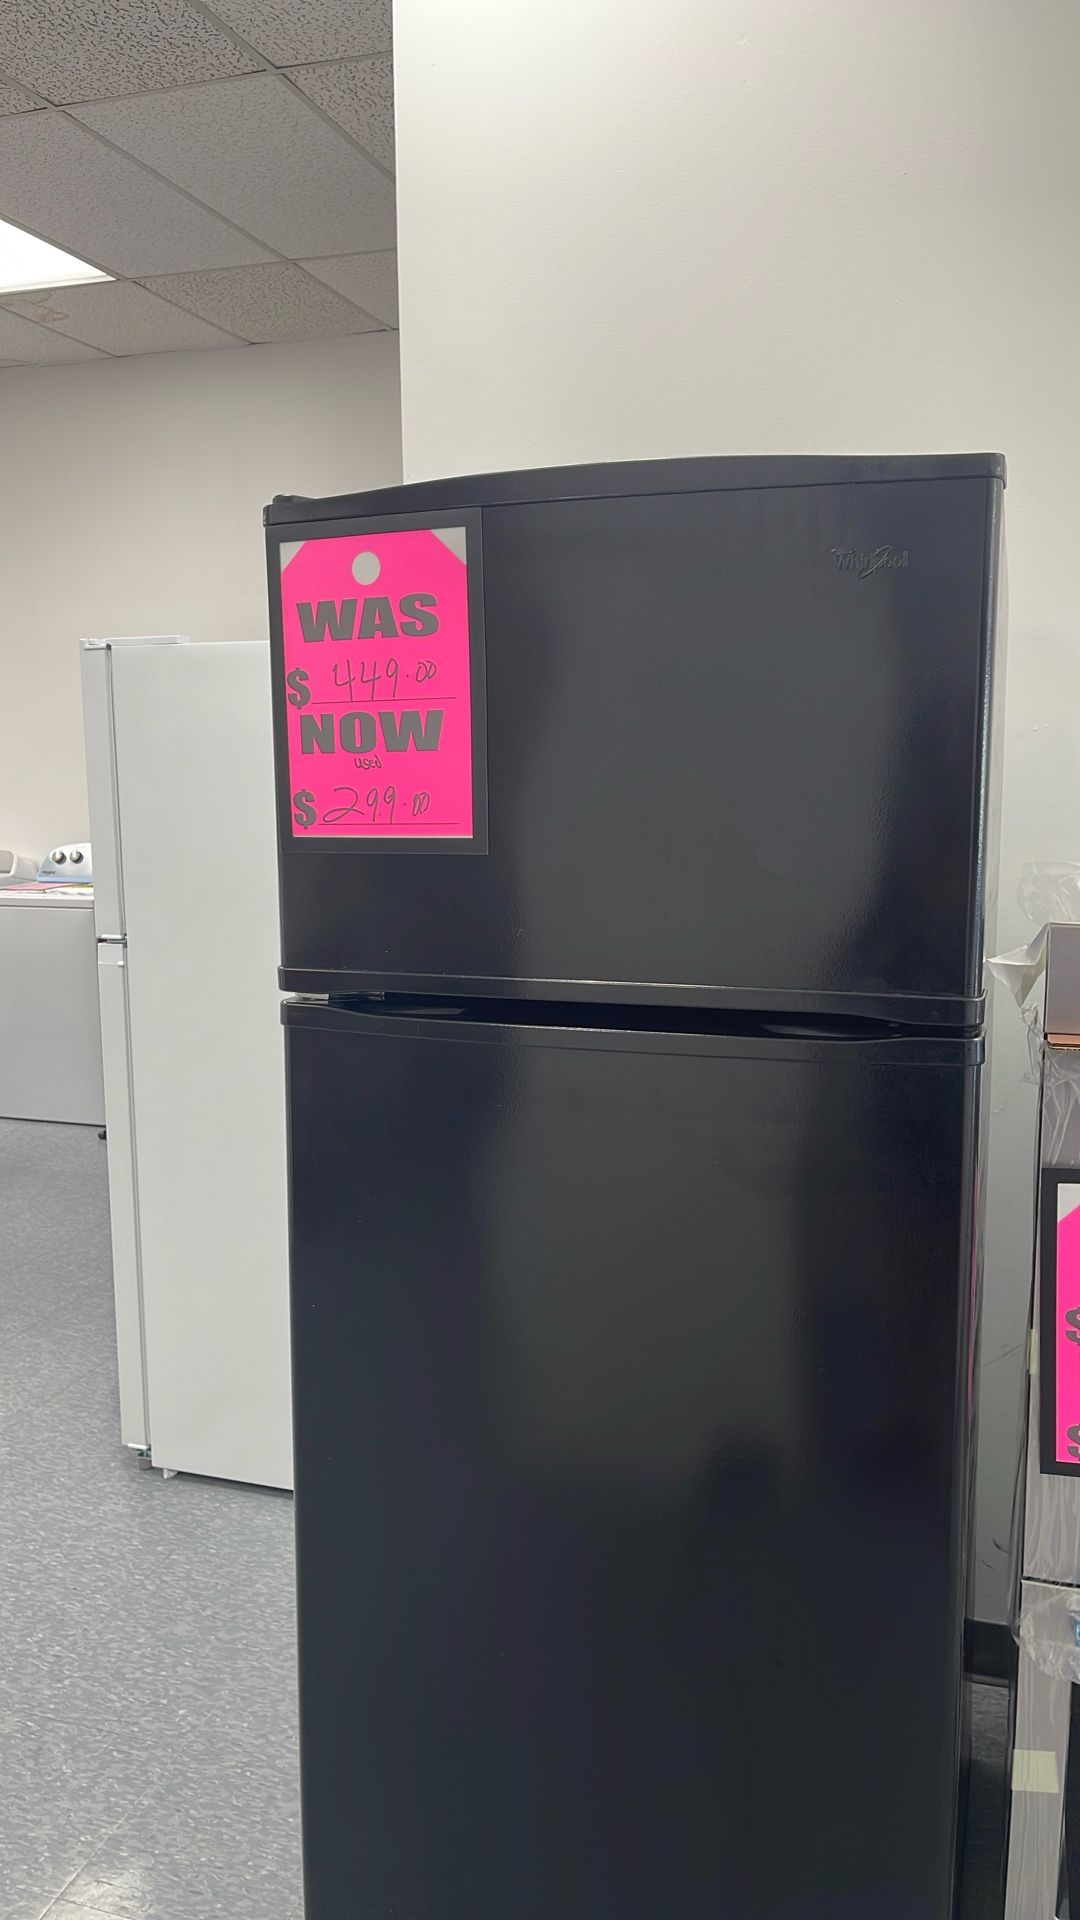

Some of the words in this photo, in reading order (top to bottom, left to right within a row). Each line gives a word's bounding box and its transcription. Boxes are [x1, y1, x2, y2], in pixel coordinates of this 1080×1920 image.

[295, 592, 440, 643] WAS
[286, 667, 311, 710] $
[332, 657, 437, 701] 449.00
[300, 708, 445, 755] NOW
[293, 788, 317, 830] $
[322, 785, 430, 824] 299.00
